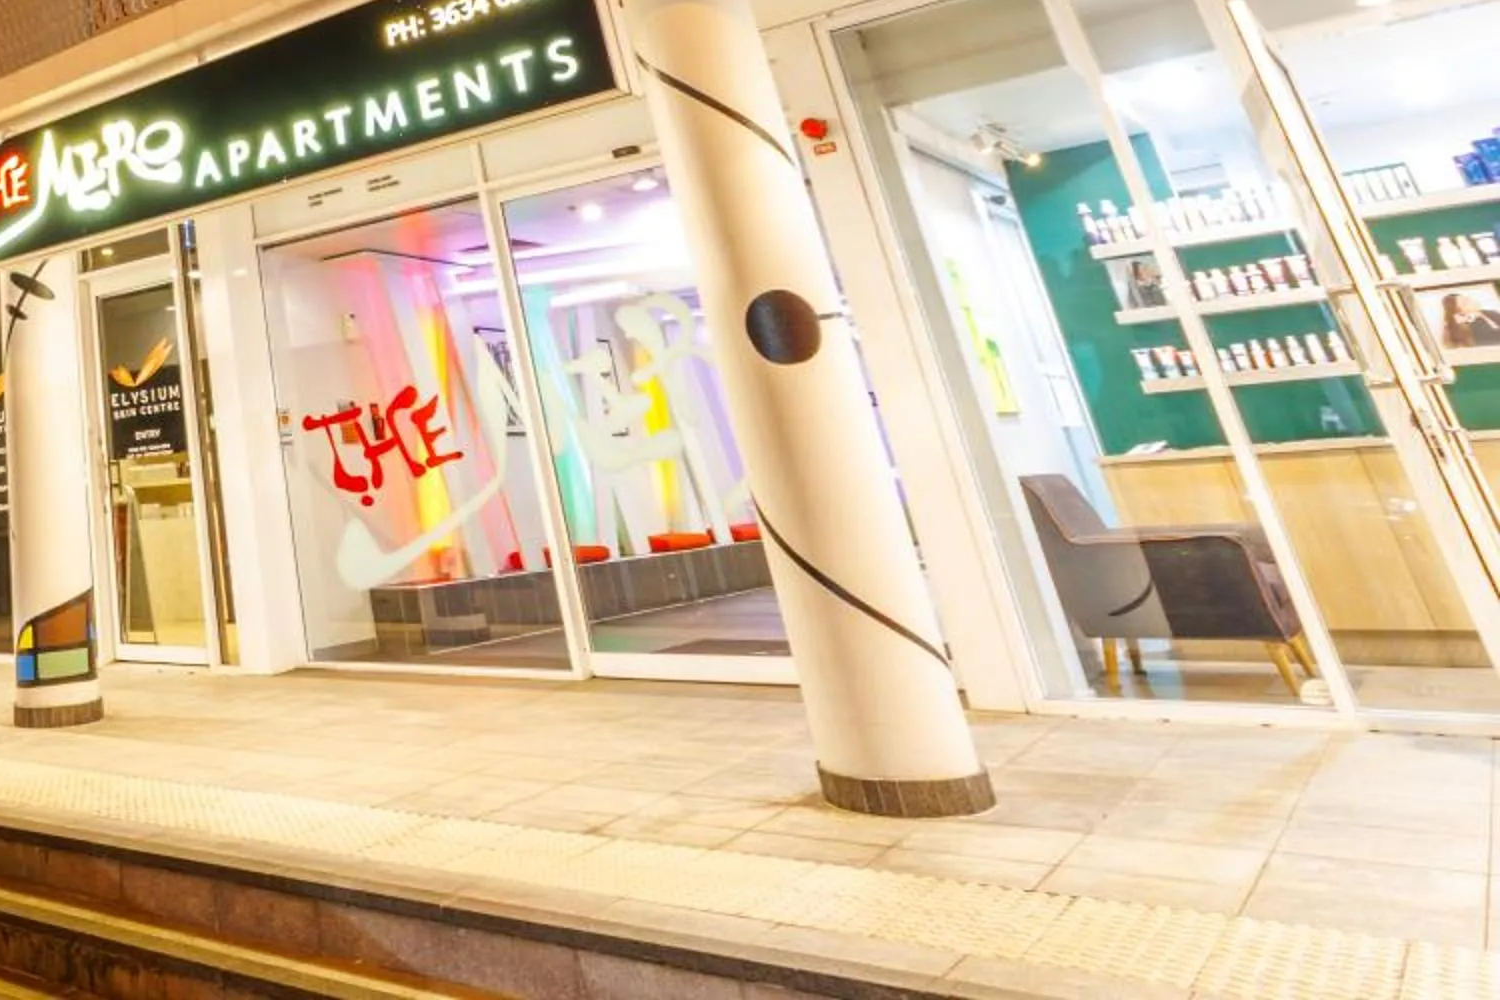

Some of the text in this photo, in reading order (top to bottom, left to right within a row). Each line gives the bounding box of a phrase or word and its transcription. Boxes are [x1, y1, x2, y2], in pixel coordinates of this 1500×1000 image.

[385, 15, 427, 47] PH:
[195, 37, 579, 187] APARTMENTS
[111, 384, 181, 408] ELYSIUM
[140, 401, 181, 416] CENTRE
[302, 385, 464, 507] THE
